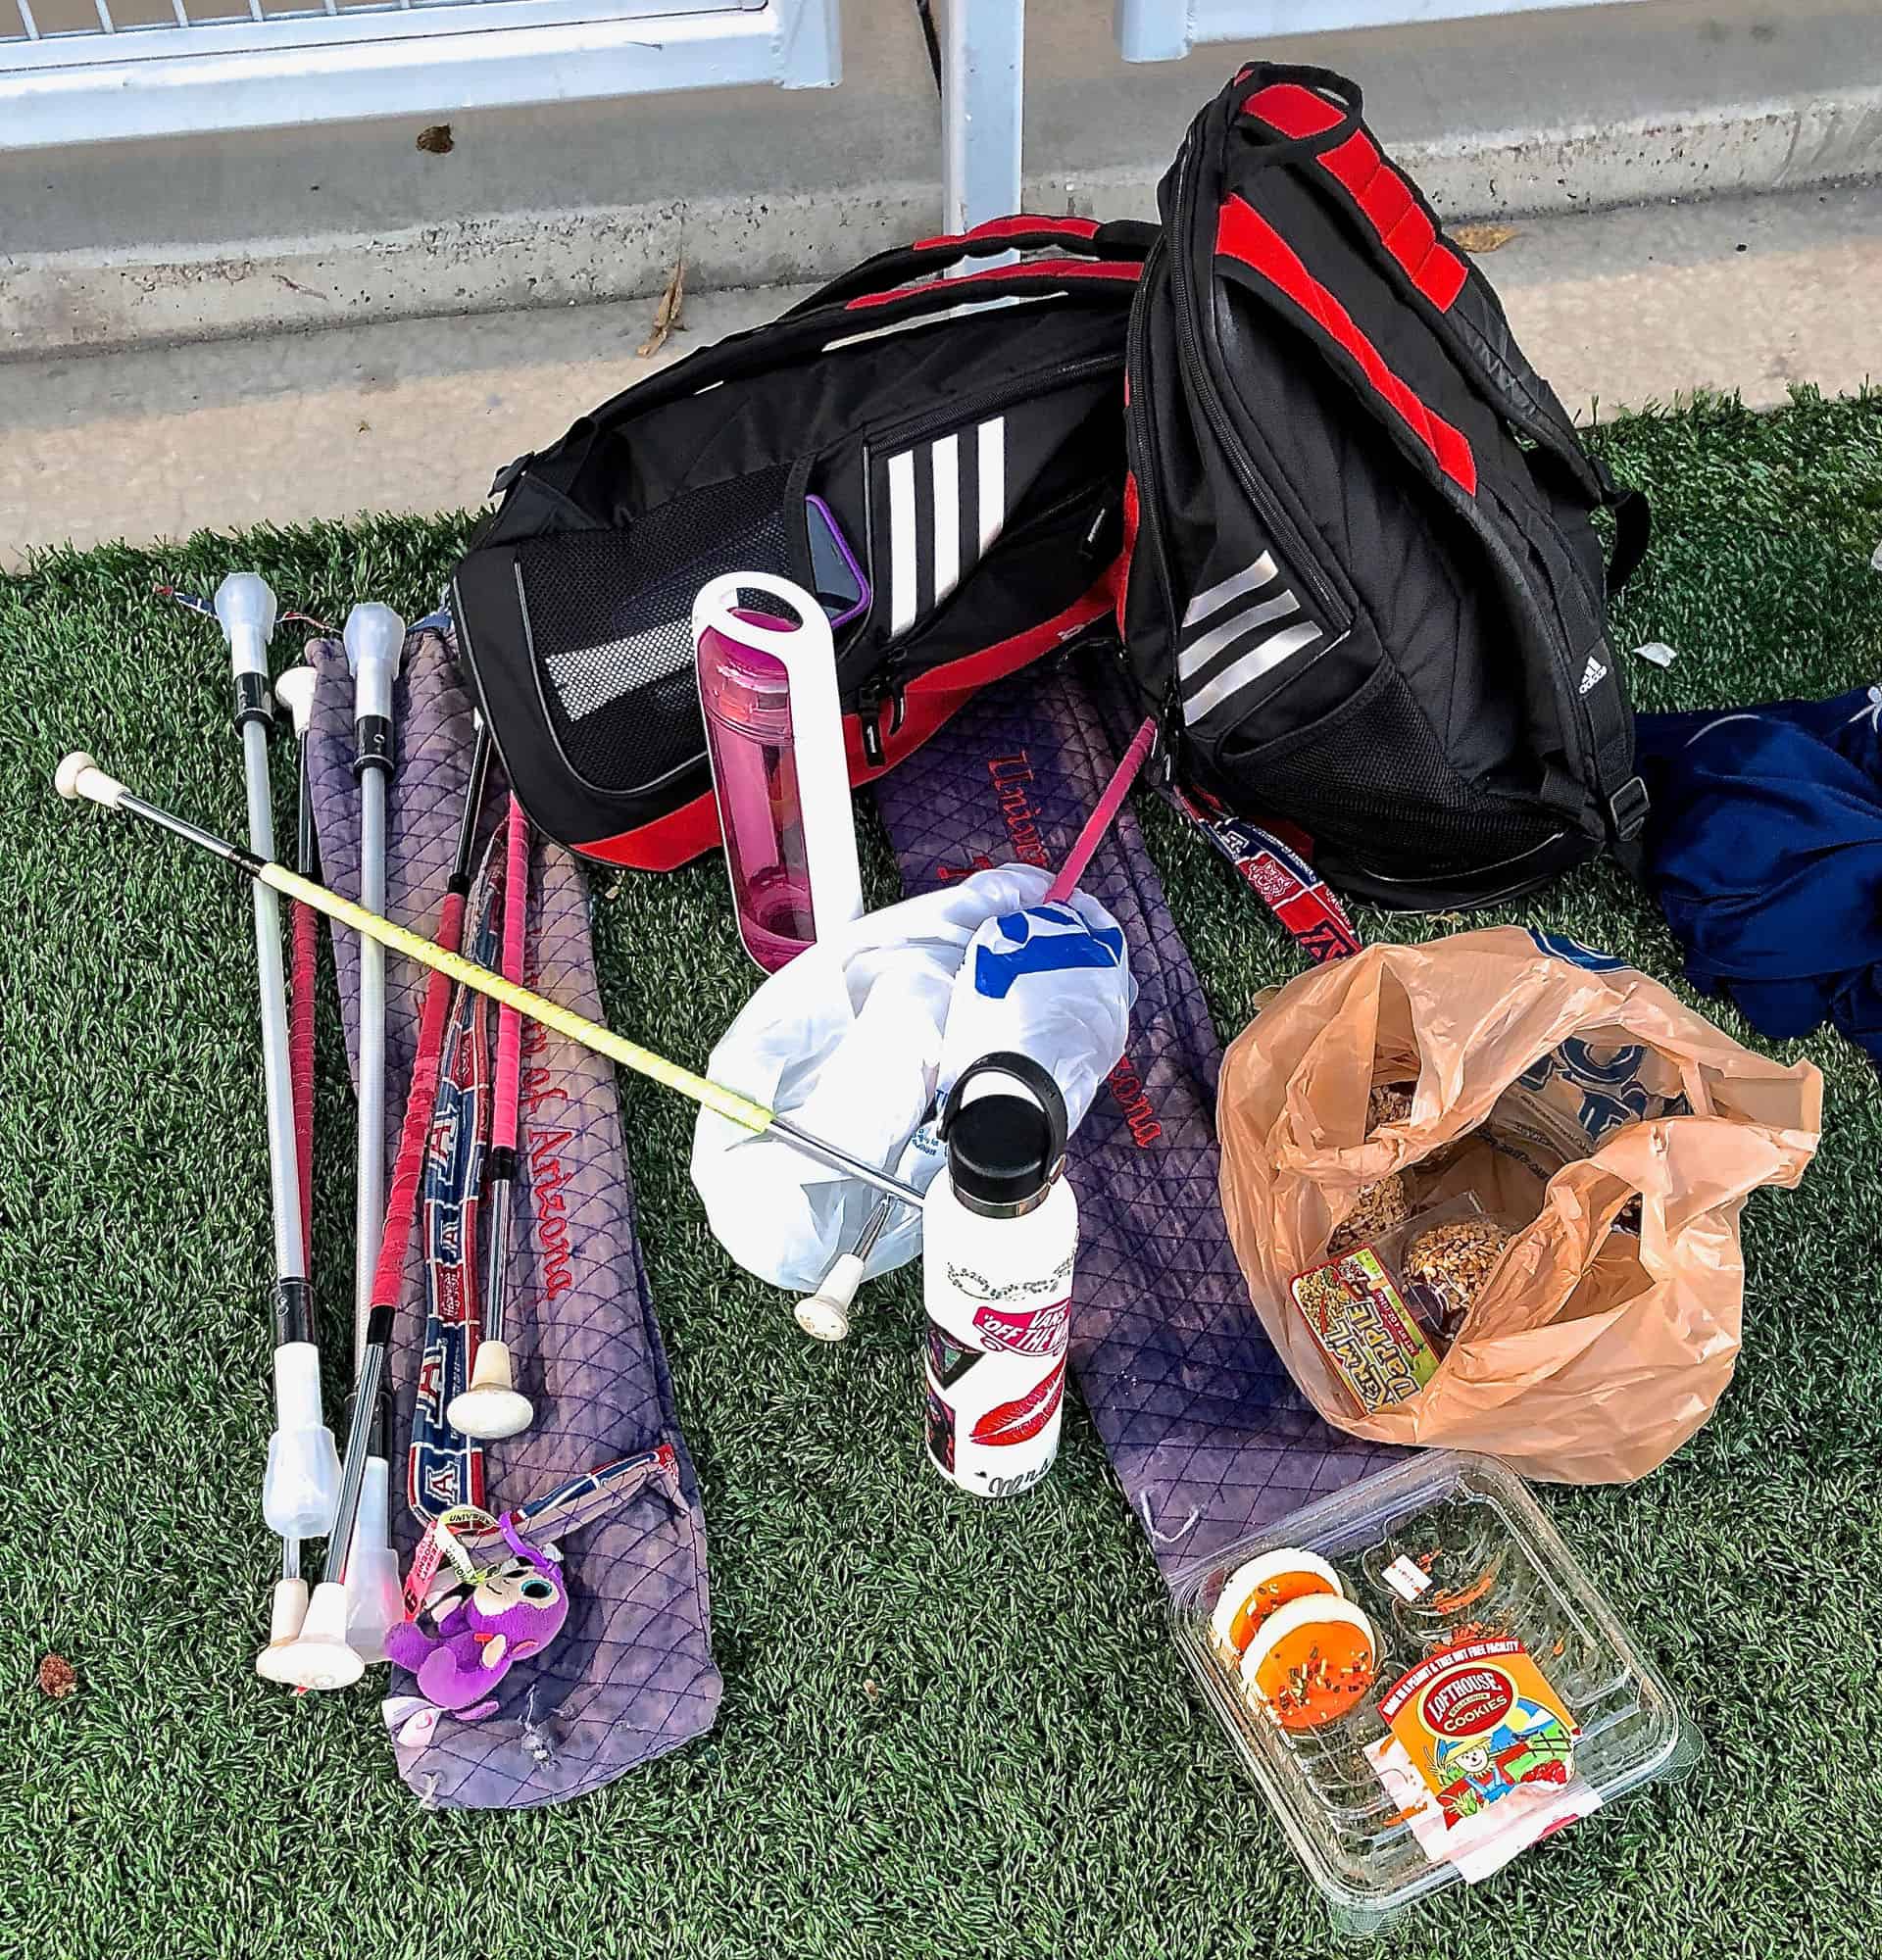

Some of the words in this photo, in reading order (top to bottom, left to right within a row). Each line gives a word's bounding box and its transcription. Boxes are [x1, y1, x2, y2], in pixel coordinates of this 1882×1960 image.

[528, 1129, 573, 1301] Arizona
[425, 1461, 461, 1506] A
[1426, 1672, 1503, 1723] LOFTHOUSE
[1443, 1694, 1508, 1732] COOKIES
